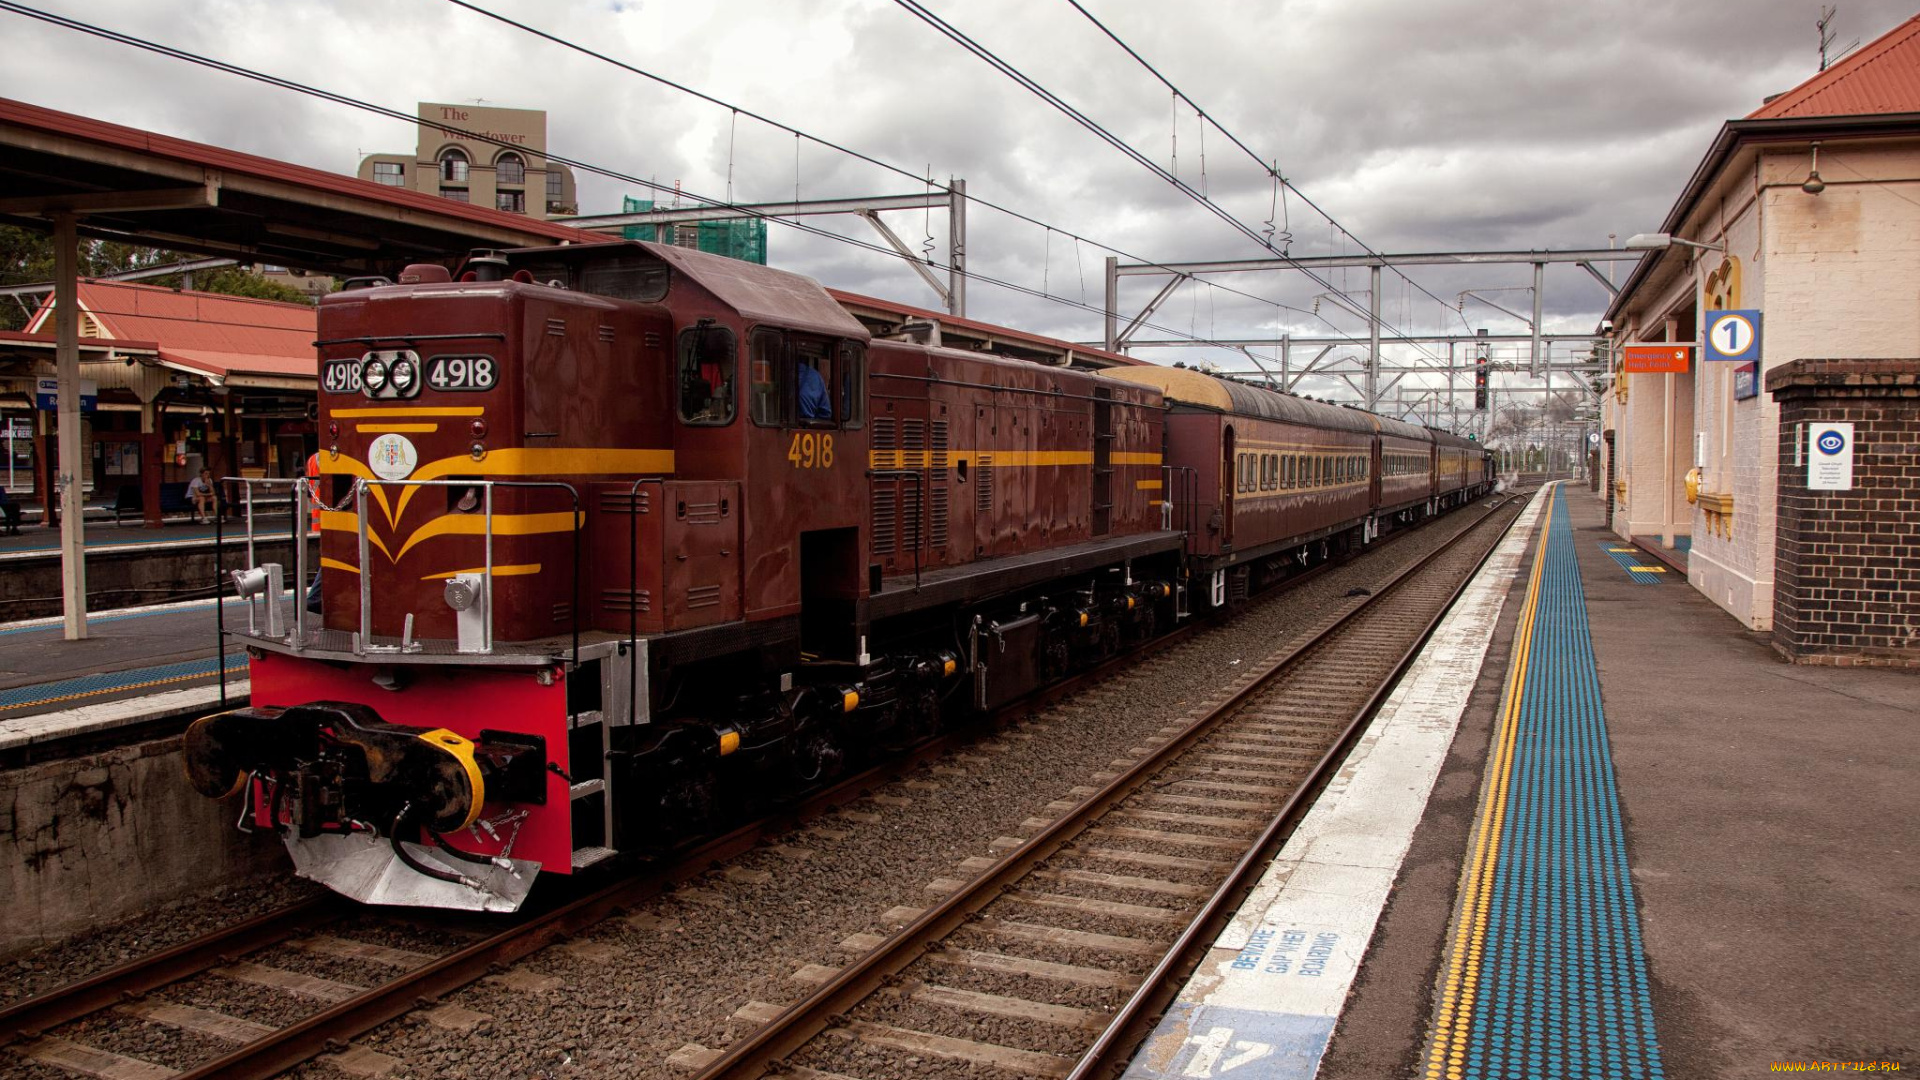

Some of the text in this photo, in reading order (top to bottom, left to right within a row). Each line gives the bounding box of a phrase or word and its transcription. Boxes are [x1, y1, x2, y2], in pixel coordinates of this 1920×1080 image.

[440, 107, 469, 121] The
[1722, 320, 1737, 350] 1
[1628, 352, 1672, 361] Emergency
[326, 363, 362, 390] 4918
[431, 358, 493, 388] 4918
[788, 433, 833, 469] 4918
[1231, 929, 1276, 970] BEWARE
[1264, 929, 1308, 974] GAP WHEN
[1298, 932, 1341, 976] BOARDING
